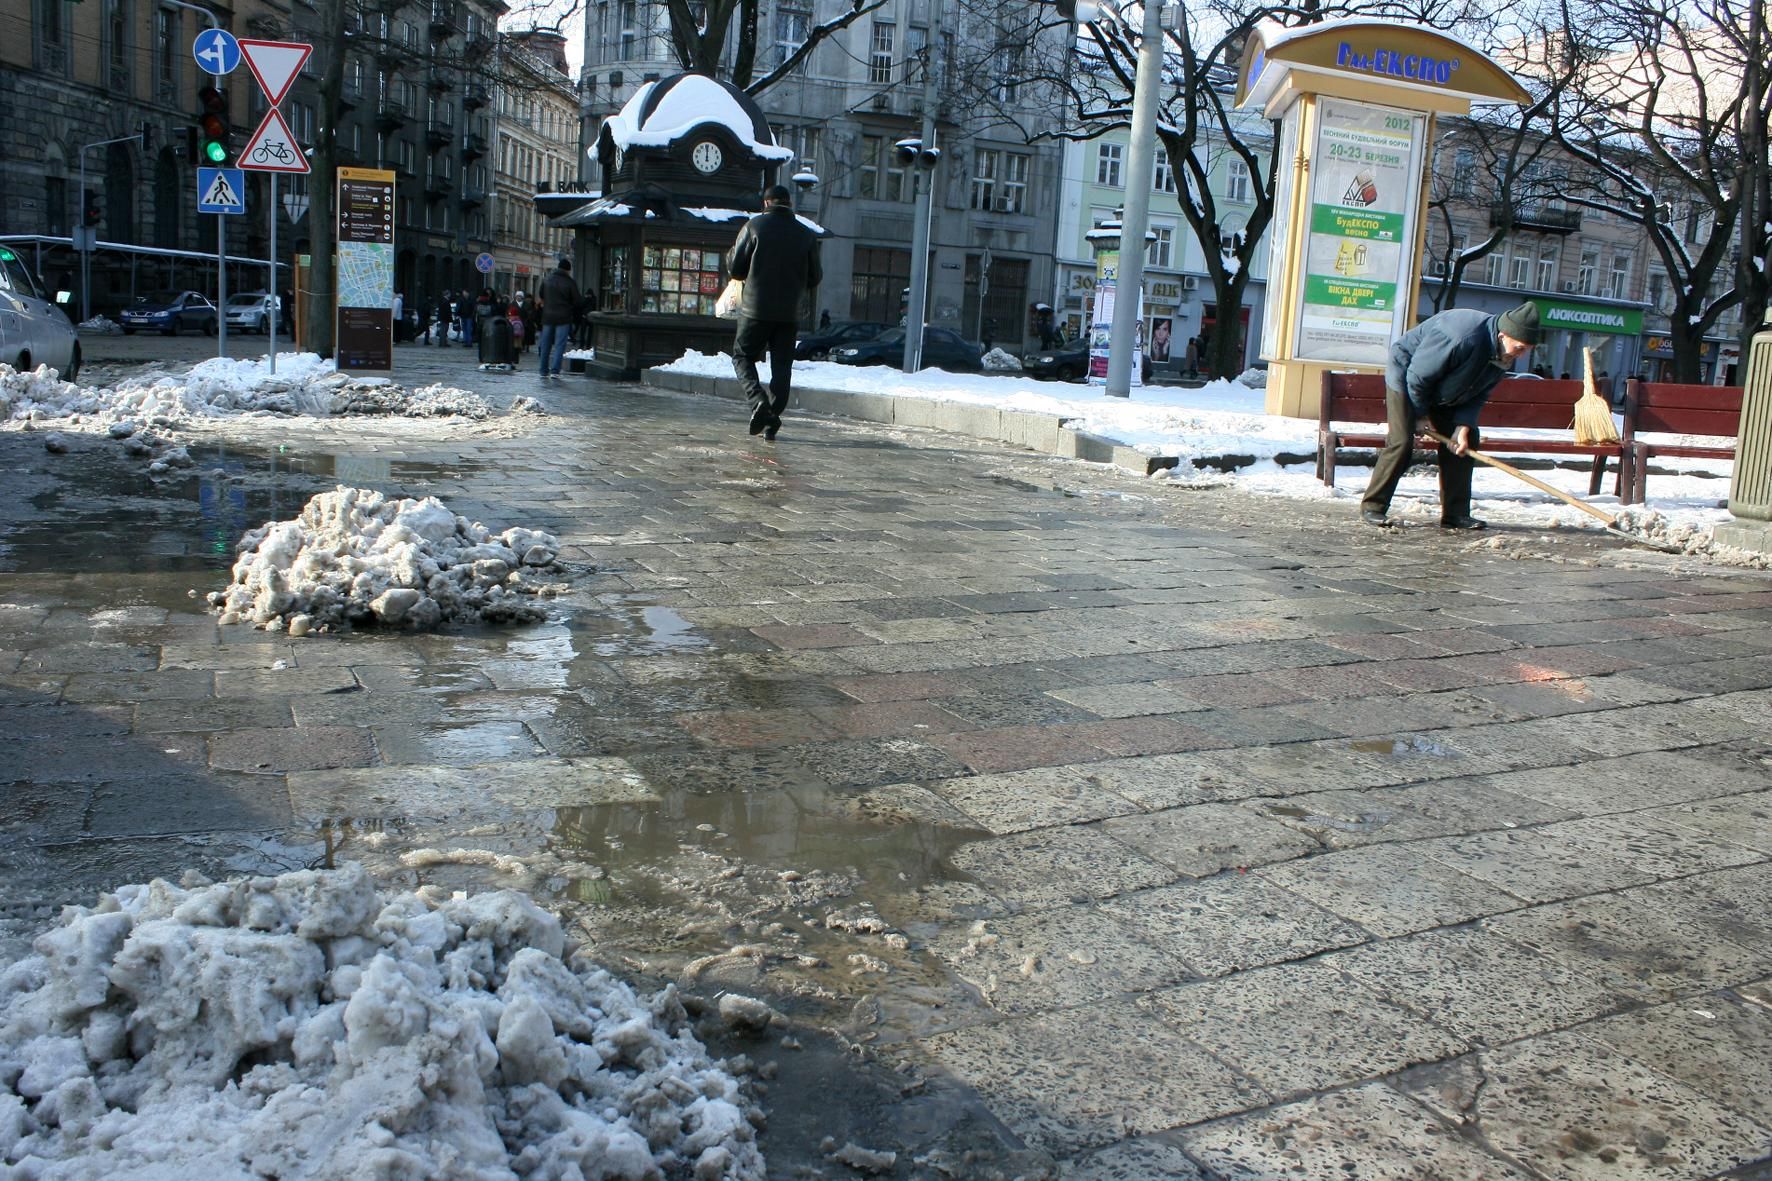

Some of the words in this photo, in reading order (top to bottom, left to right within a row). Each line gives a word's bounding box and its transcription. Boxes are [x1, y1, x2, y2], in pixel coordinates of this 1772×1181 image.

[1385, 116, 1410, 131] 2012
[1330, 143, 1361, 159] 20-23
[1547, 308, 1625, 327] ЛЮКСОПТИКА
